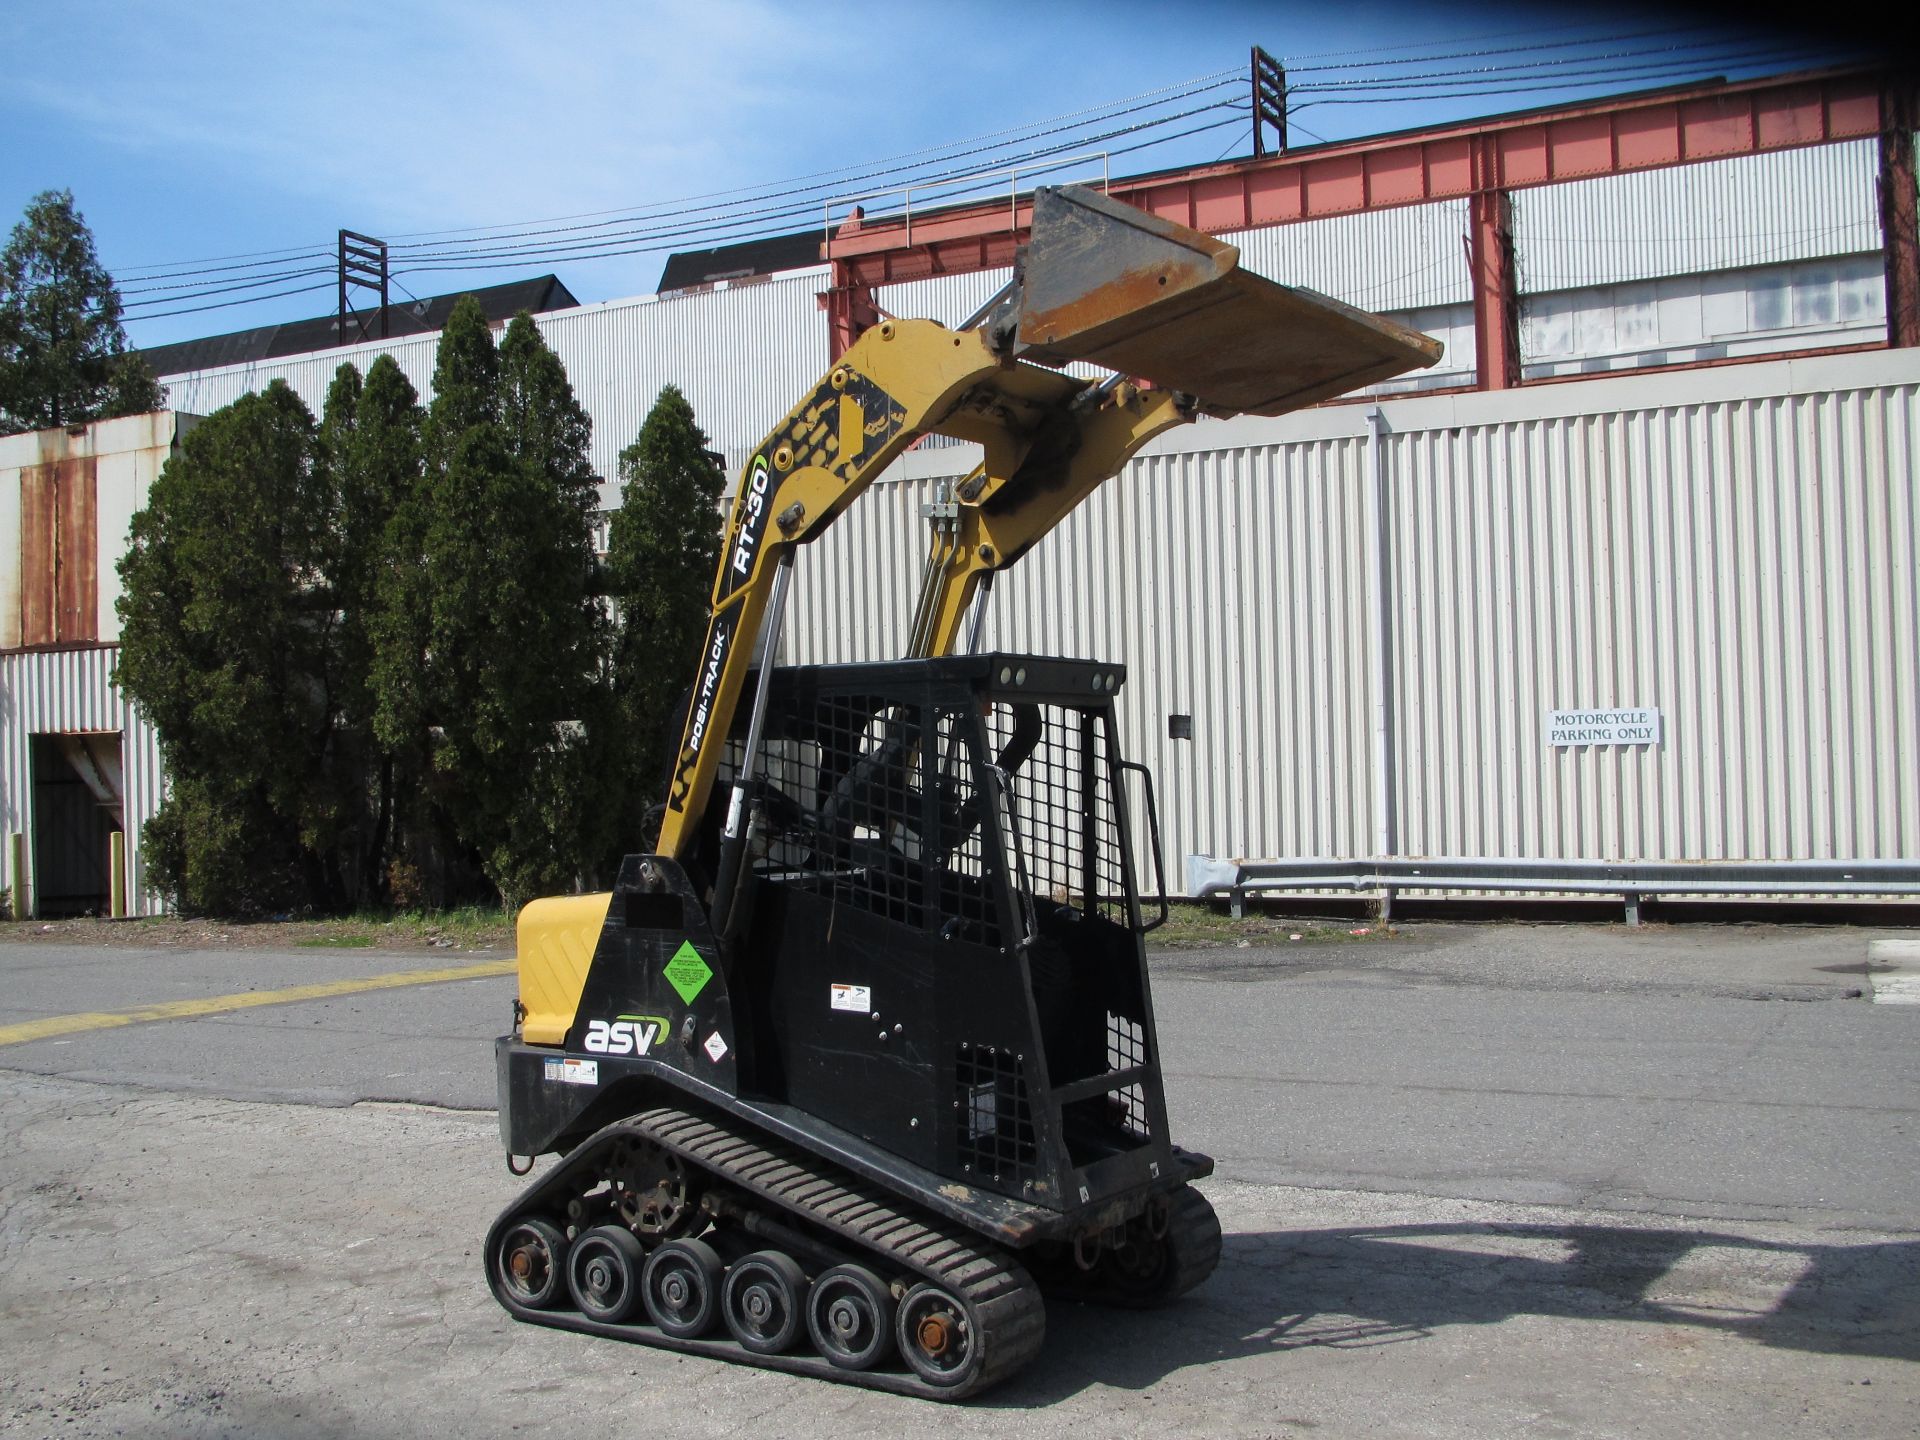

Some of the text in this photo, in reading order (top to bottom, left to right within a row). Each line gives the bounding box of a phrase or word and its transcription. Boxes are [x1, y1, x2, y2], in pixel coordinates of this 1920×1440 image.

[734, 468, 768, 574] RT-30
[690, 630, 725, 752] POSI-TRACK
[1555, 713, 1647, 725] MOTORCYCLE
[1551, 727, 1653, 741] PARKING ONLY
